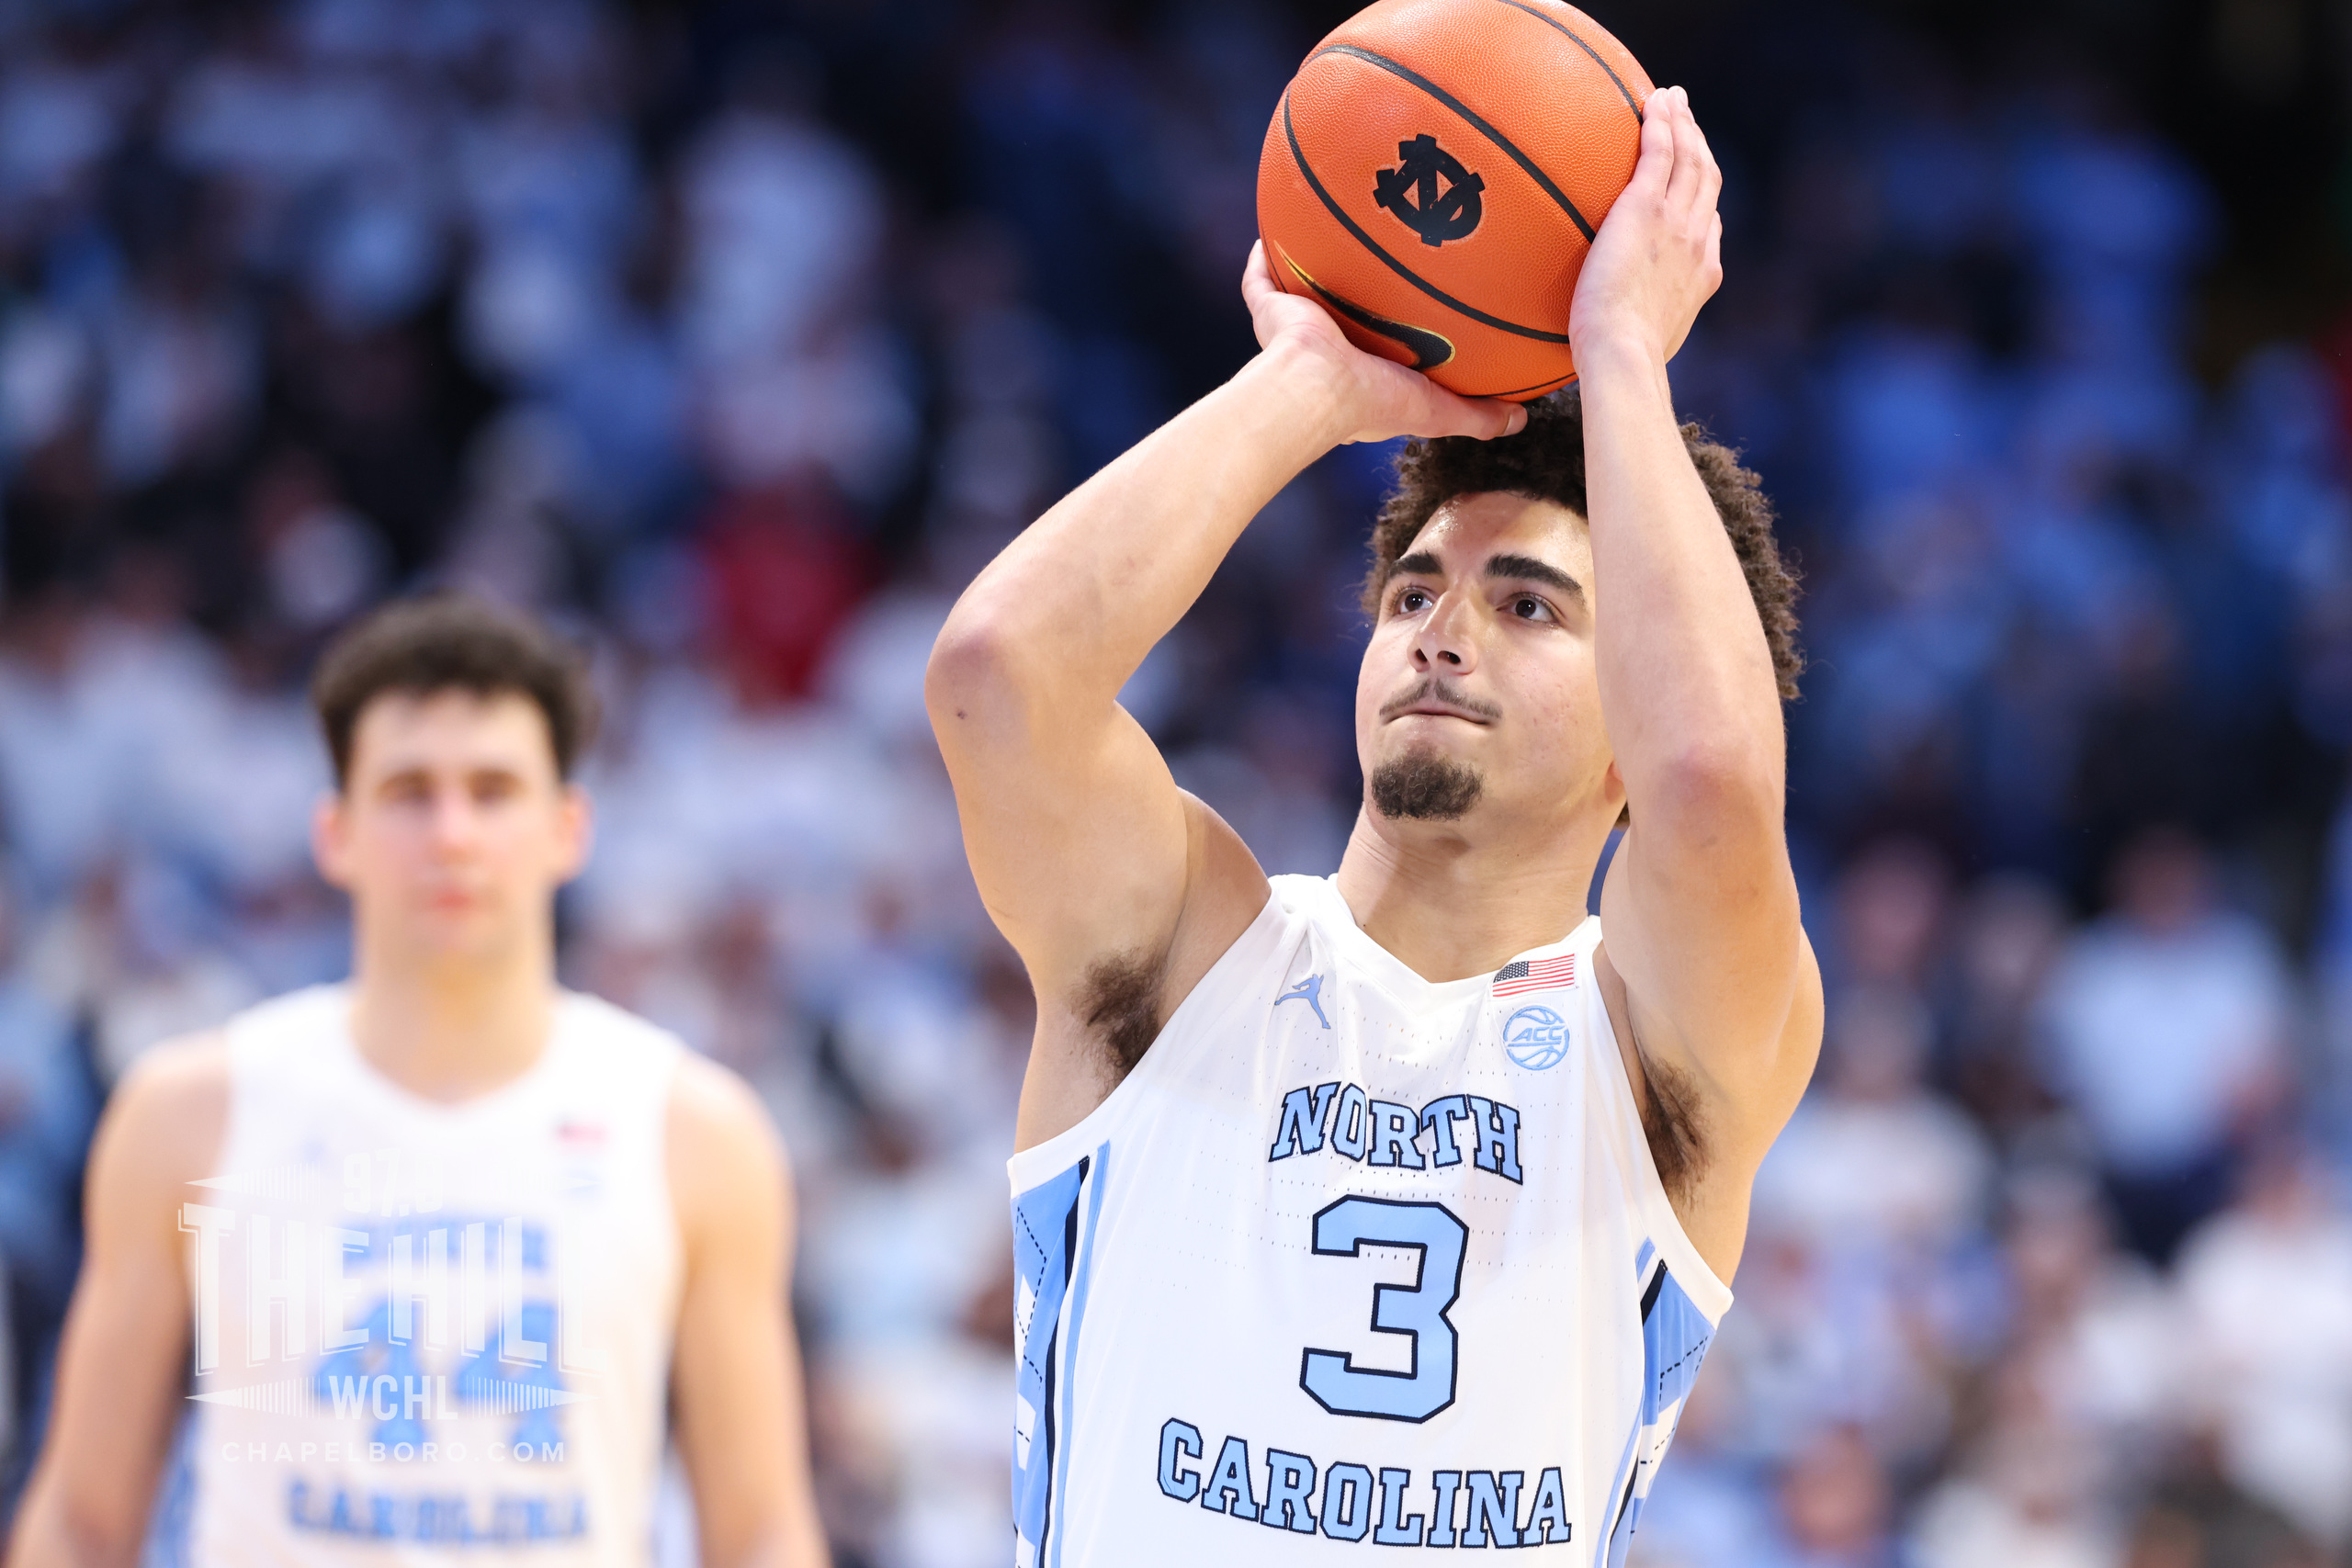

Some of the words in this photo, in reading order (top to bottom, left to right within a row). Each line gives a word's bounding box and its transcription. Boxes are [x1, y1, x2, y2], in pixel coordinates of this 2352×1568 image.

[1511, 1026, 1564, 1042] ACC
[1268, 1081, 1523, 1186] NORTH
[1299, 1194, 1470, 1424] 3
[1157, 1417, 1571, 1550] CAROLINA
